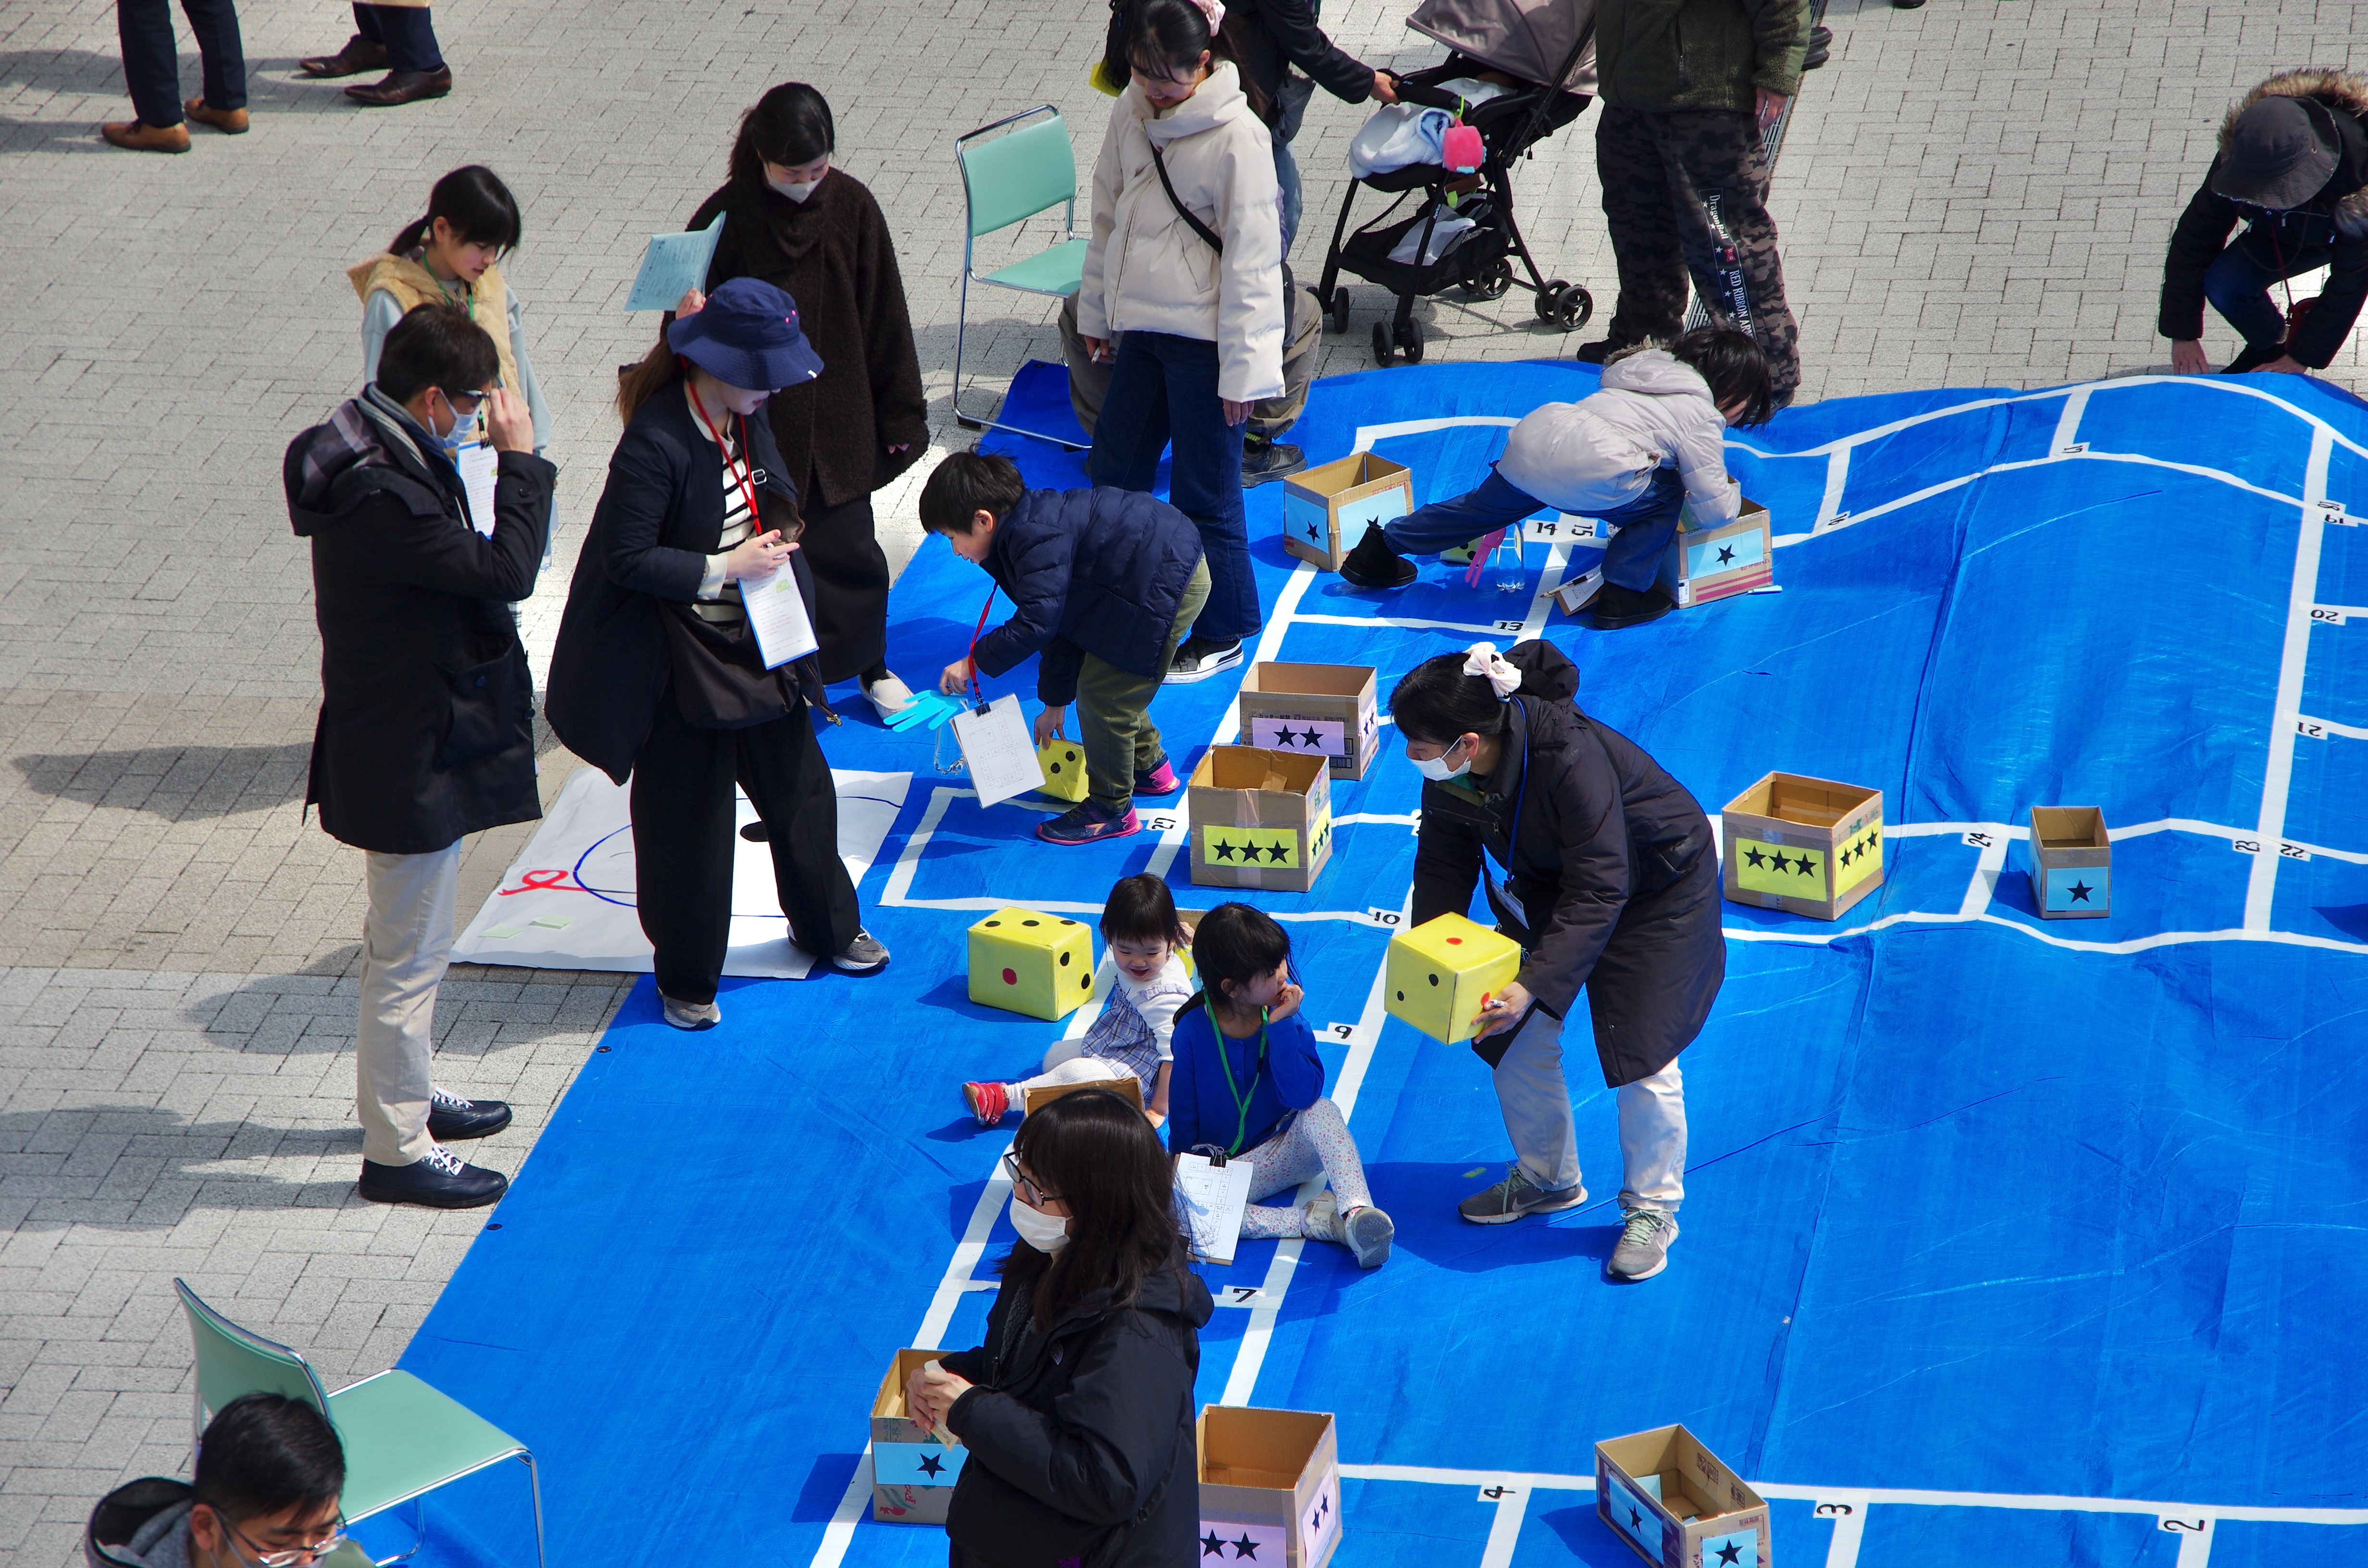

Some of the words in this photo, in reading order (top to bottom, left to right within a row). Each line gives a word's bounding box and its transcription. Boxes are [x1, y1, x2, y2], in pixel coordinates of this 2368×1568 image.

[1710, 194, 1729, 240] DragonBall
[1729, 270, 1742, 287] RED
[1733, 287, 1748, 318] RIBBON
[2061, 445, 2083, 453] 17
[2317, 501, 2341, 511] 18
[1828, 514, 1848, 526] 16
[2325, 514, 2345, 524] 19
[1536, 522, 1558, 535] 14
[1572, 524, 1593, 537] 15
[2310, 609, 2339, 622] 20
[1497, 622, 1523, 631] 13
[2297, 721, 2322, 736] 21
[1152, 818, 1176, 829] 27
[1968, 833, 1994, 847] 24
[2235, 841, 2260, 852] 23
[2281, 843, 2305, 858] 22
[1374, 911, 1400, 924] 10
[1334, 1026, 1352, 1039] 9
[1233, 1288, 1257, 1302] 7
[1483, 1486, 1516, 1500] 4
[1816, 1504, 1852, 1515] 3
[2163, 1519, 2205, 1531] 2
